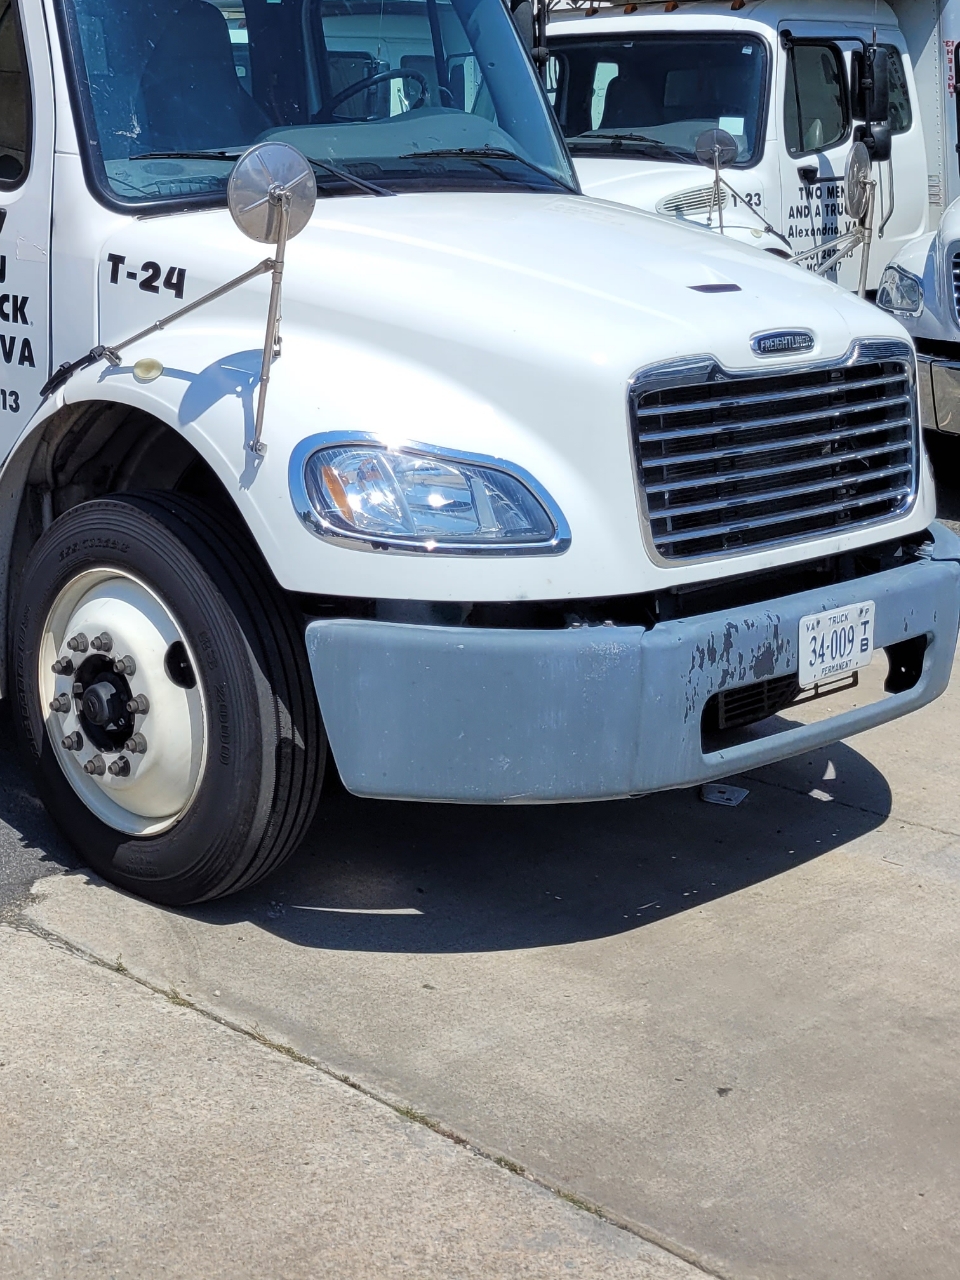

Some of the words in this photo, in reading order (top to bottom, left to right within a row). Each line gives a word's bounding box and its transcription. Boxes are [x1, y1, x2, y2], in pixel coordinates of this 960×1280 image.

[798, 186, 822, 200] TWO
[789, 205, 809, 219] AND
[815, 205, 822, 218] A
[825, 203, 848, 216] TRU
[106, 253, 187, 299] T-24
[761, 334, 812, 350] FREIGHTLINER
[0, 334, 37, 368] VA
[828, 612, 849, 627] TRUCK
[809, 625, 855, 666] 34-009
[821, 659, 852, 677] PERMANENT
